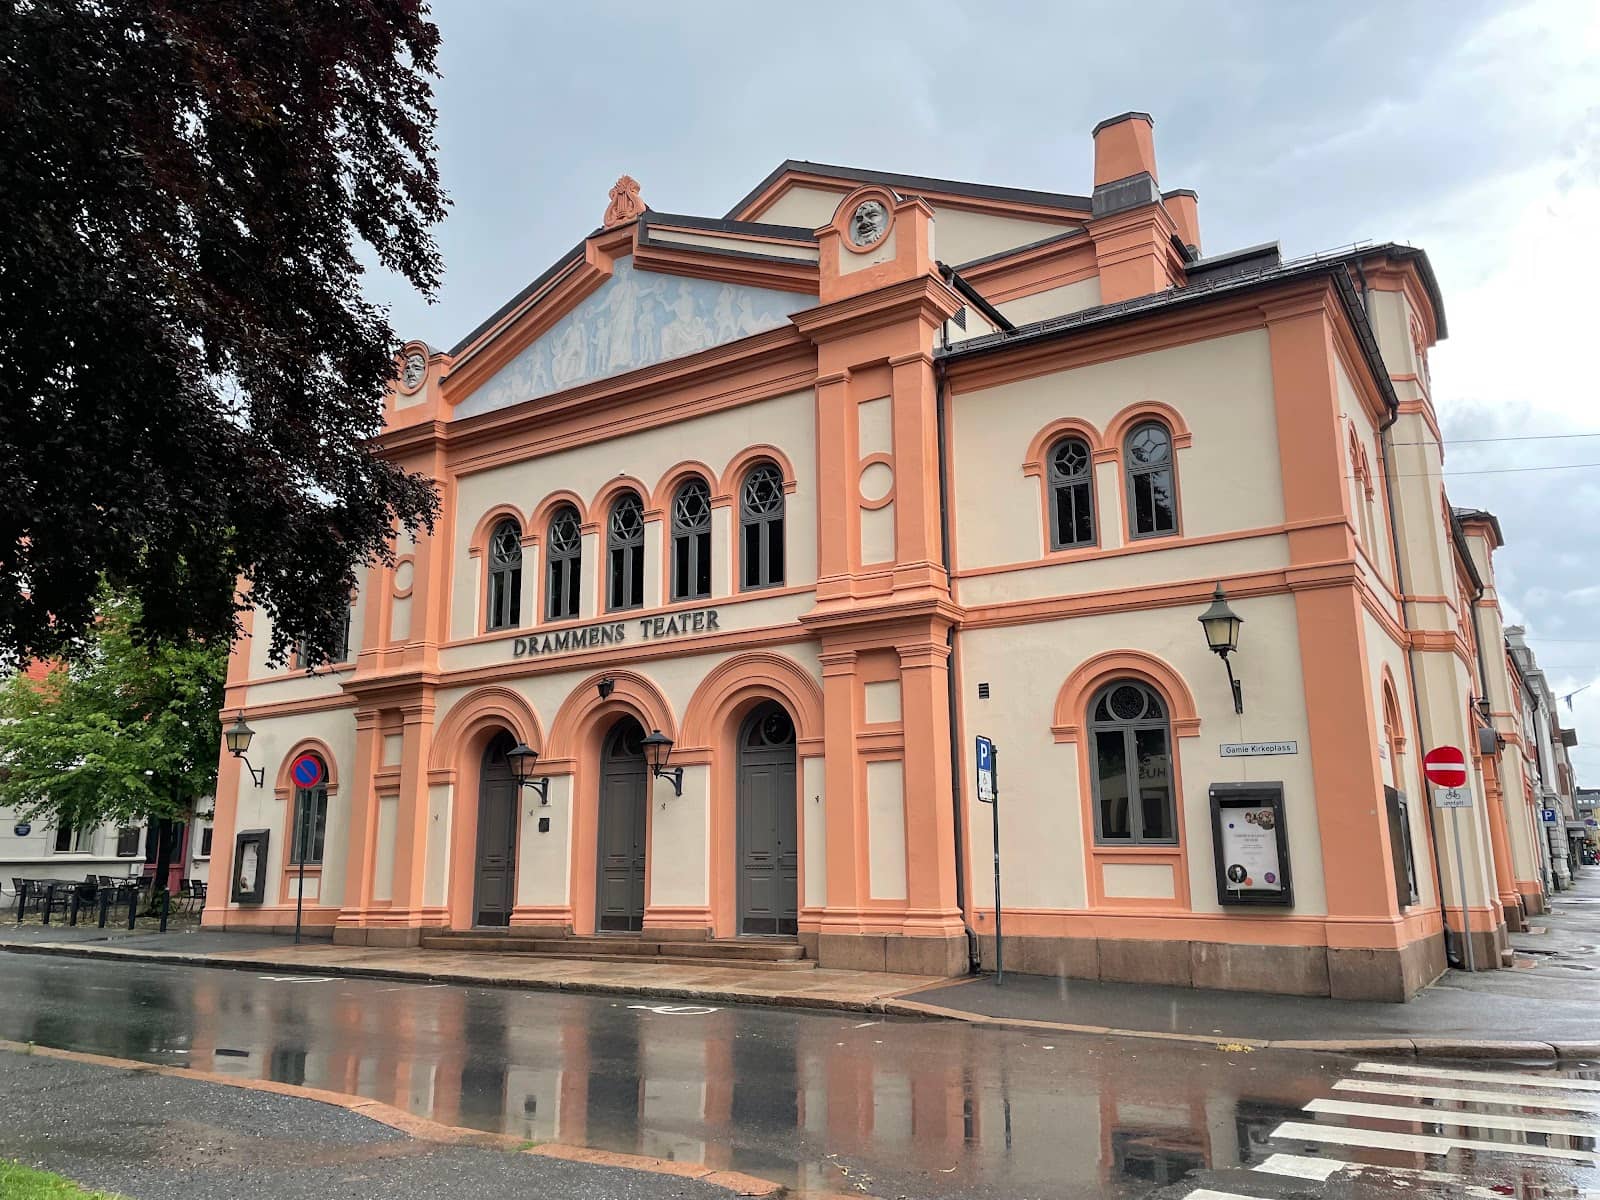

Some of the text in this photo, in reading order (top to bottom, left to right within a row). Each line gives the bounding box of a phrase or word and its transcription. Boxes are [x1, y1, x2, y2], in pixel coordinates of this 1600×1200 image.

[513, 609, 720, 656] DRAMMENS TEATER
[980, 743, 988, 766] P
[1226, 744, 1291, 754] Gamle Kirkeplass
[1544, 811, 1553, 821] P
